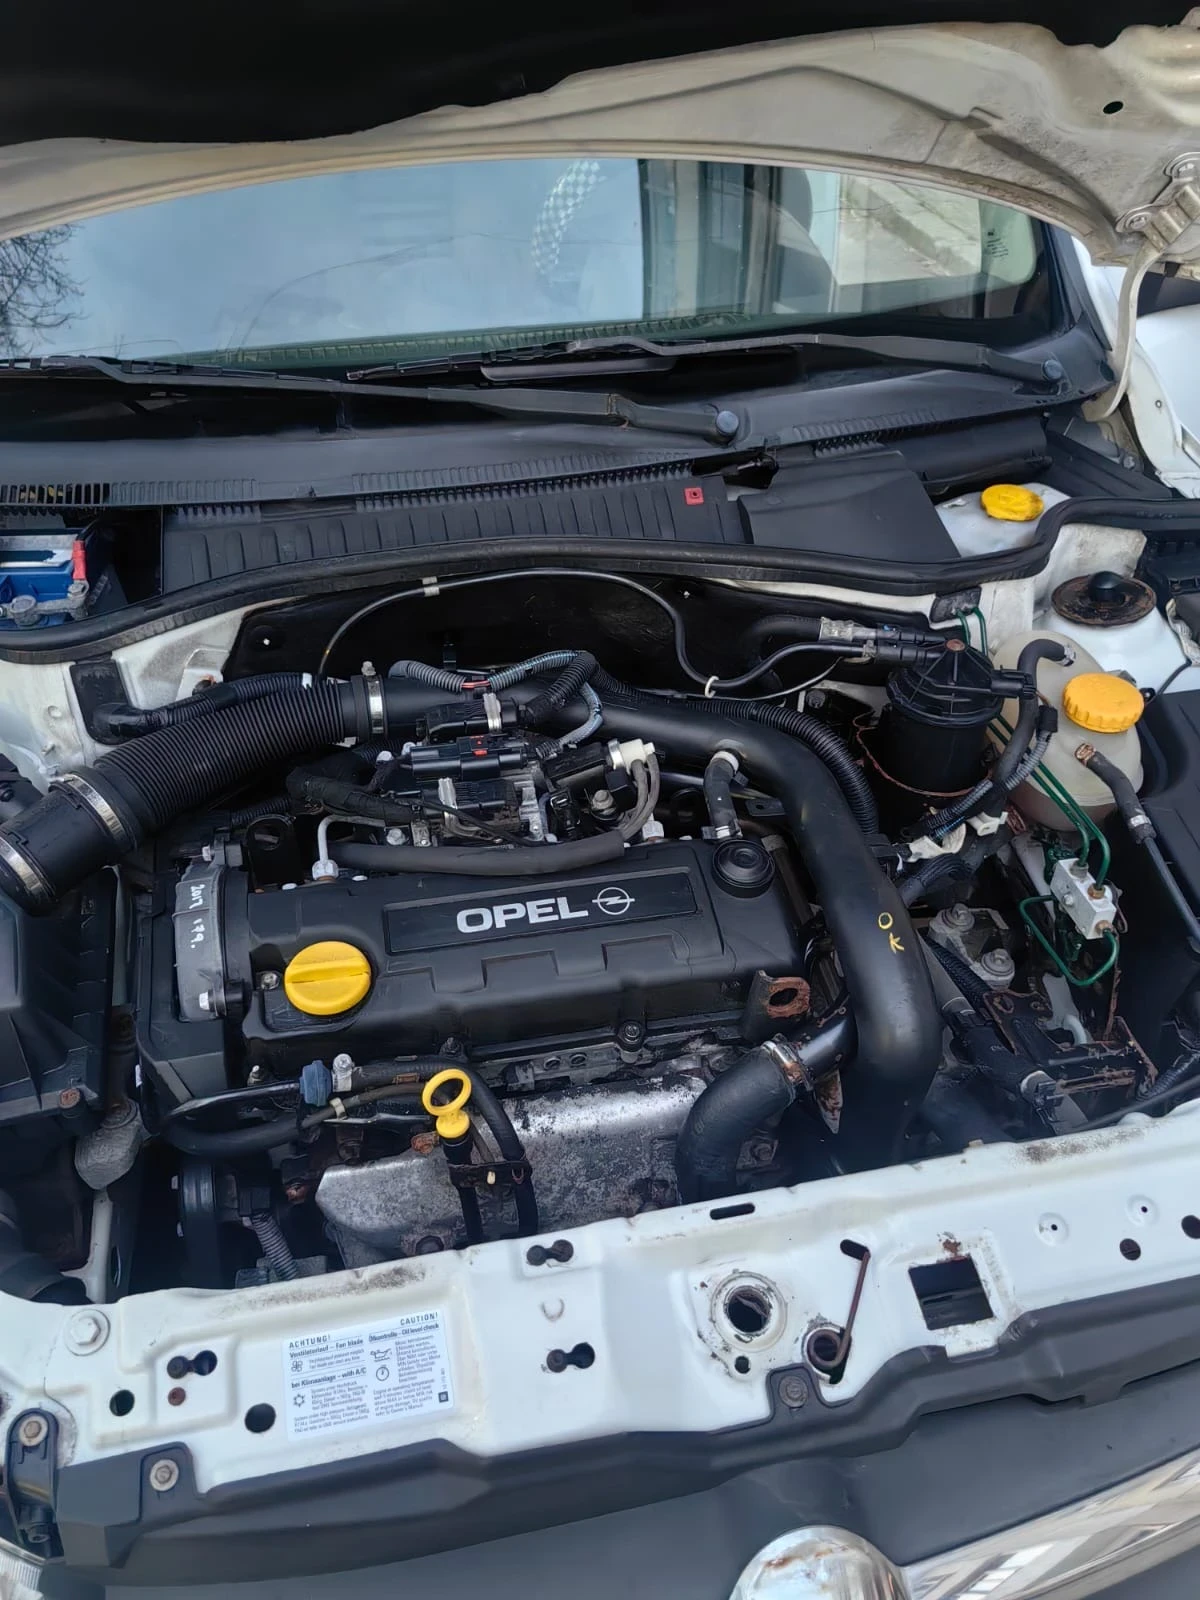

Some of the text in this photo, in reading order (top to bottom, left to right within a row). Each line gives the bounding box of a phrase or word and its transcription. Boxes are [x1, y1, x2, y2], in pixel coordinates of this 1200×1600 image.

[456, 896, 588, 933] OPEL
[400, 1311, 438, 1326] CAUTION!
[423, 1323, 439, 1331] check
[289, 1334, 330, 1349] ACHTUNG!
